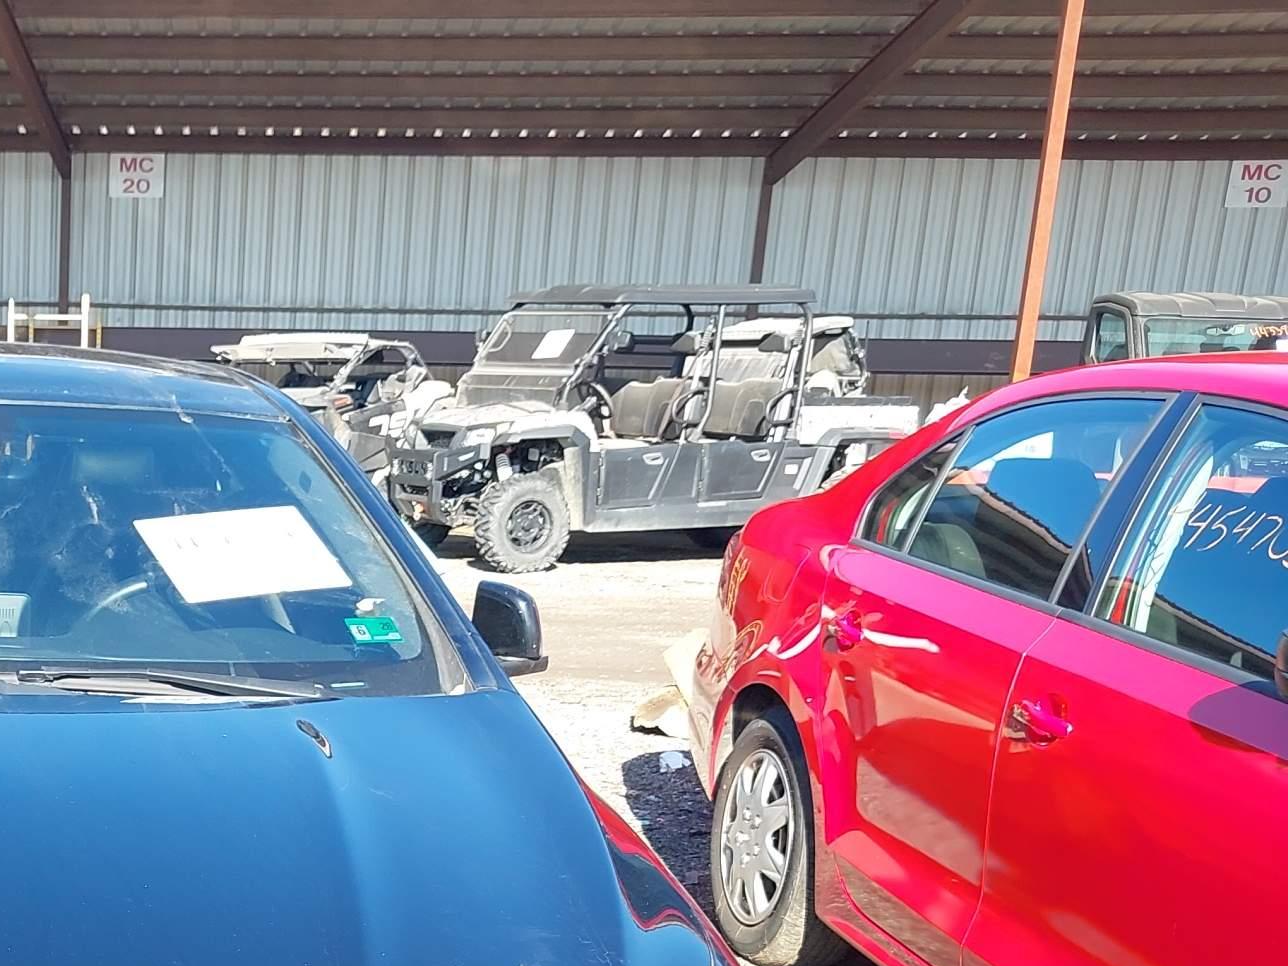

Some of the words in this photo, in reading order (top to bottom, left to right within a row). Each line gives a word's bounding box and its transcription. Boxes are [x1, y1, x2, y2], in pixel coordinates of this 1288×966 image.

[119, 157, 154, 173] MC
[1240, 163, 1283, 181] MC
[122, 178, 150, 194] 20
[1244, 187, 1272, 204] 10
[356, 625, 366, 636] 6
